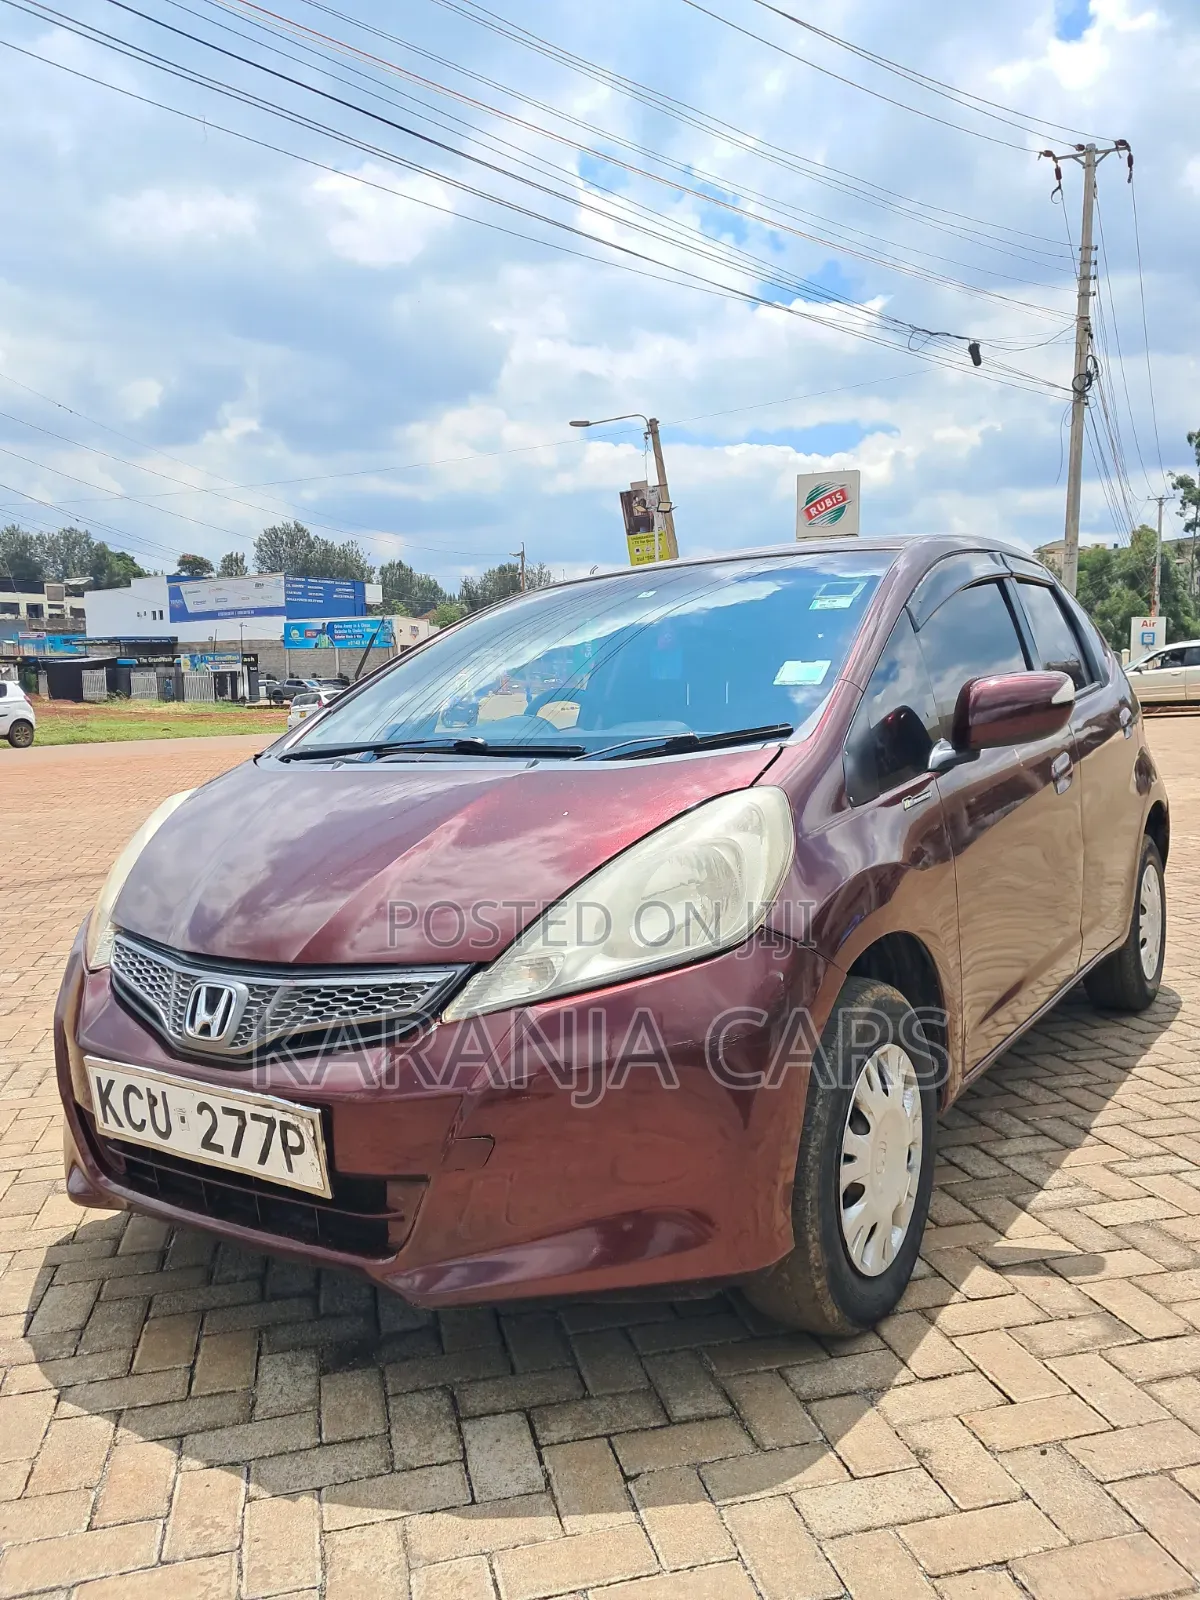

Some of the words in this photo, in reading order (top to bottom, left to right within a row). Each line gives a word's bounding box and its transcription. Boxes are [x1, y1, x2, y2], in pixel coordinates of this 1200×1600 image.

[1141, 620, 1157, 628] Air
[95, 1076, 173, 1141] KCU
[196, 1101, 306, 1174] 277P
